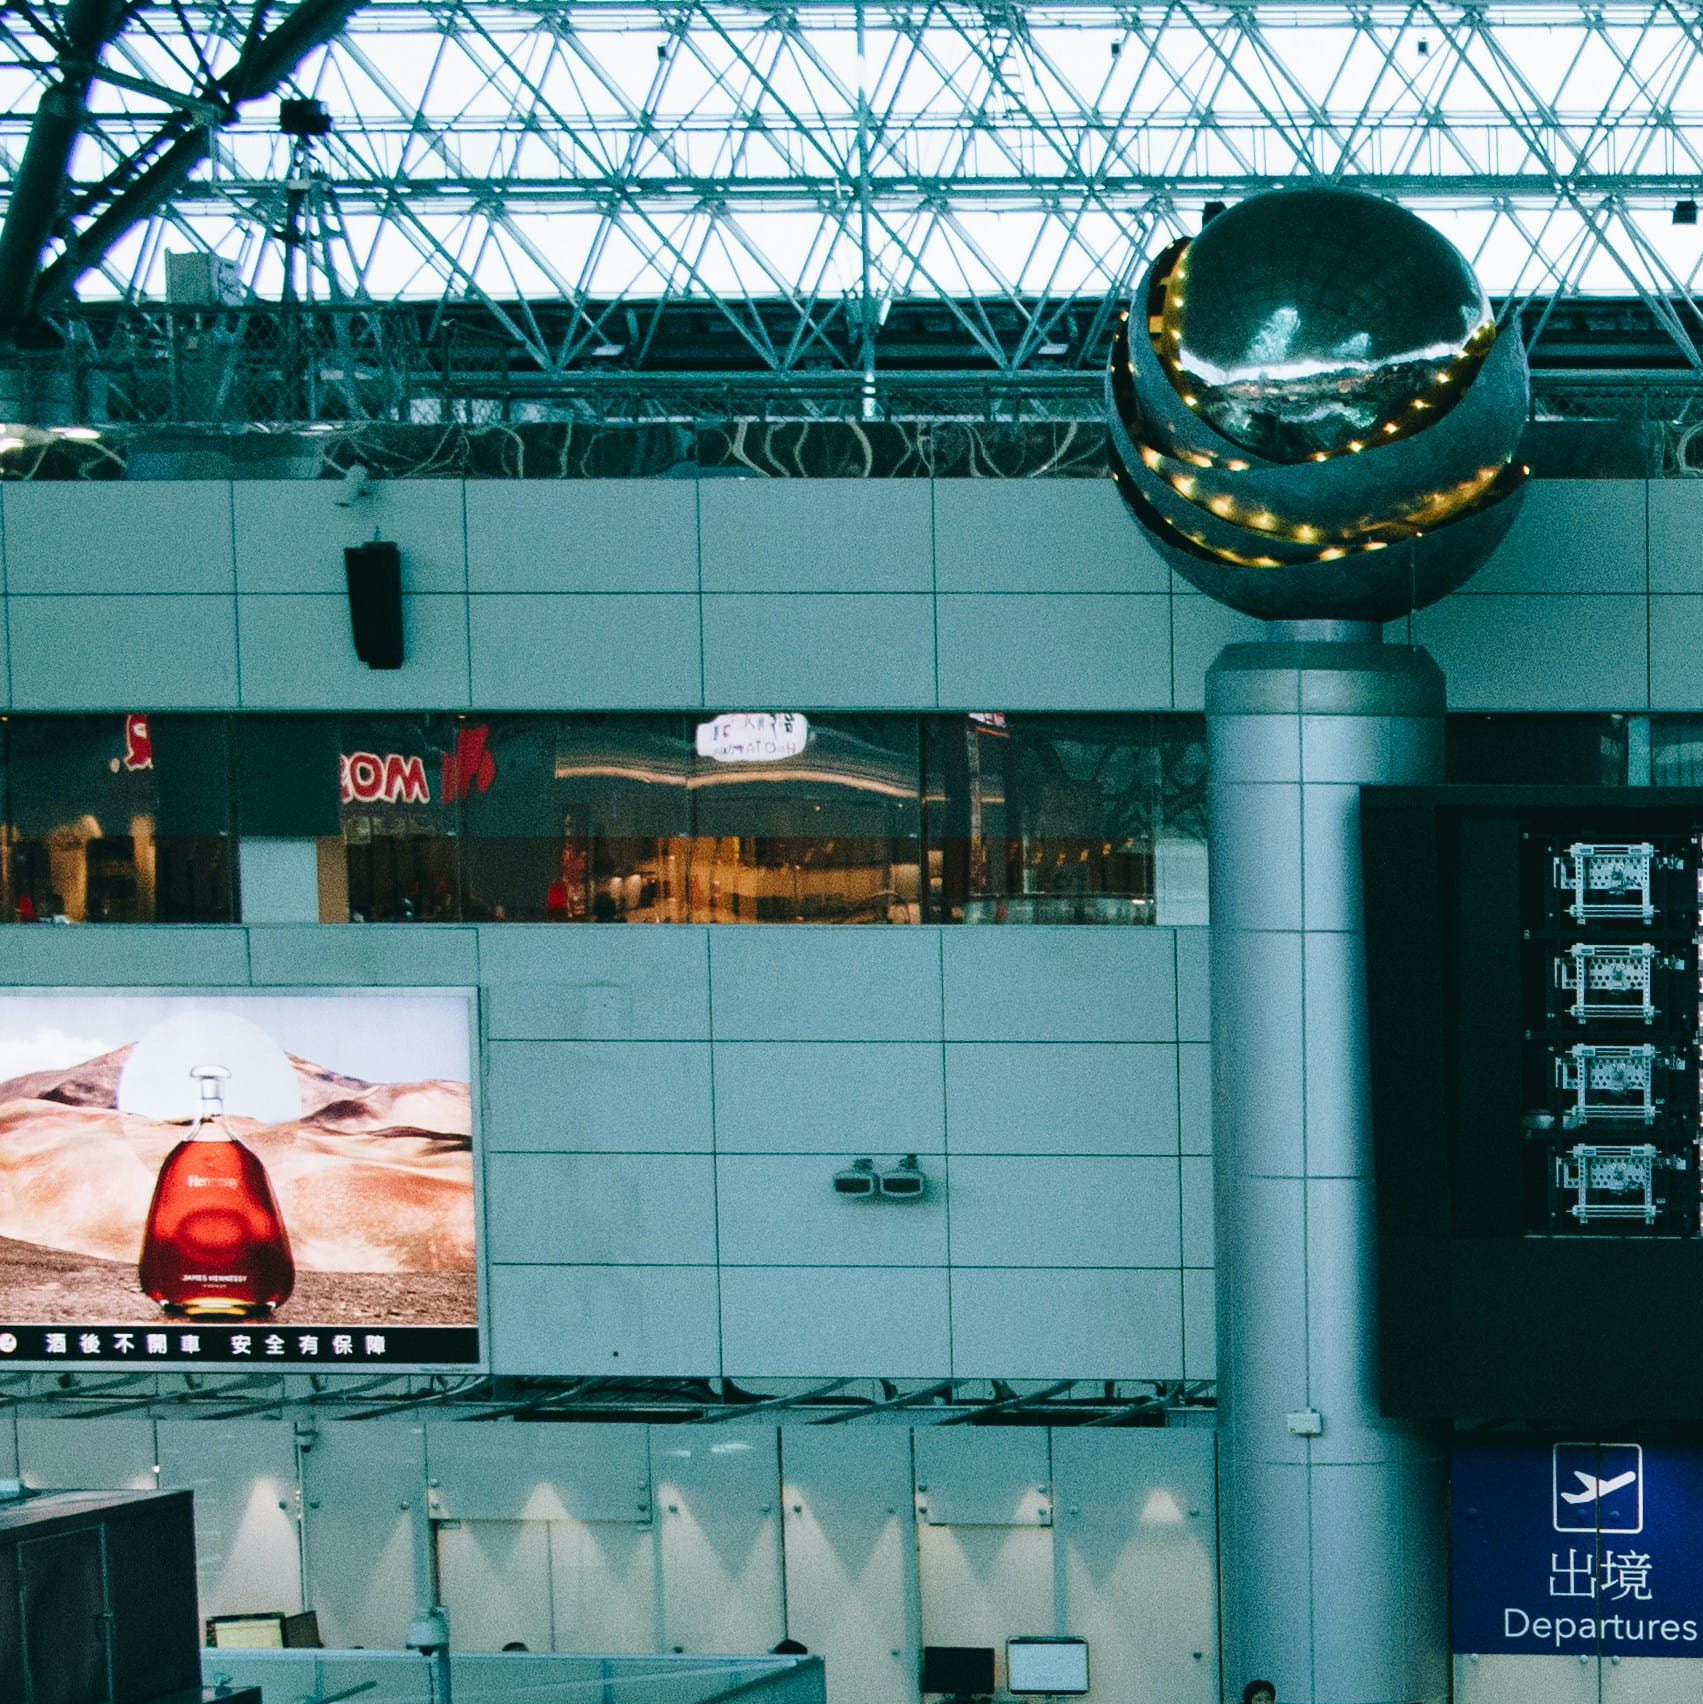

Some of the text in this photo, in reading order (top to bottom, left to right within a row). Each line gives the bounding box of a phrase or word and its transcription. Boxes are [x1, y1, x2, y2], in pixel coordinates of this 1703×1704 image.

[46, 1333, 386, 1355] 酒後不開車 安全有保障
[1549, 1549, 1653, 1602] 出境
[1503, 1607, 1699, 1647] Departures
